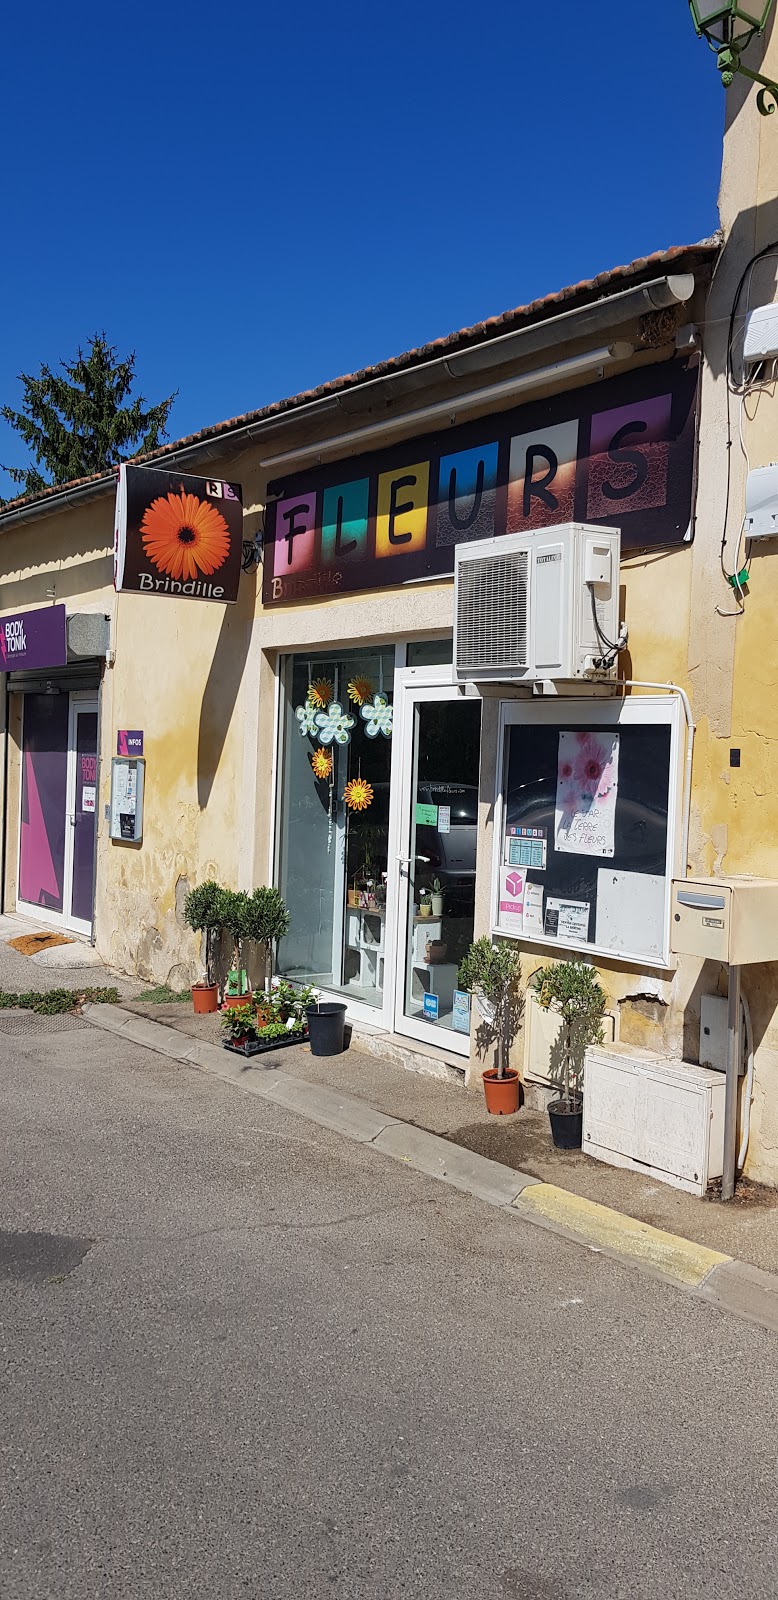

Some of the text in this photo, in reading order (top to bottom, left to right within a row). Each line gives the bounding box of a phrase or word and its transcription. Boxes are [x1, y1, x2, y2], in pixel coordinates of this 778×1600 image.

[283, 420, 648, 566] FLEURS
[138, 573, 225, 598] Brindille
[5, 620, 24, 638] BODY
[7, 630, 27, 653] TONIK
[128, 738, 142, 746] INFOS
[82, 769, 97, 782] TONI
[563, 819, 599, 832] LA TERRE
[563, 833, 607, 846] DES FLEURS
[505, 903, 521, 912] Pickup
